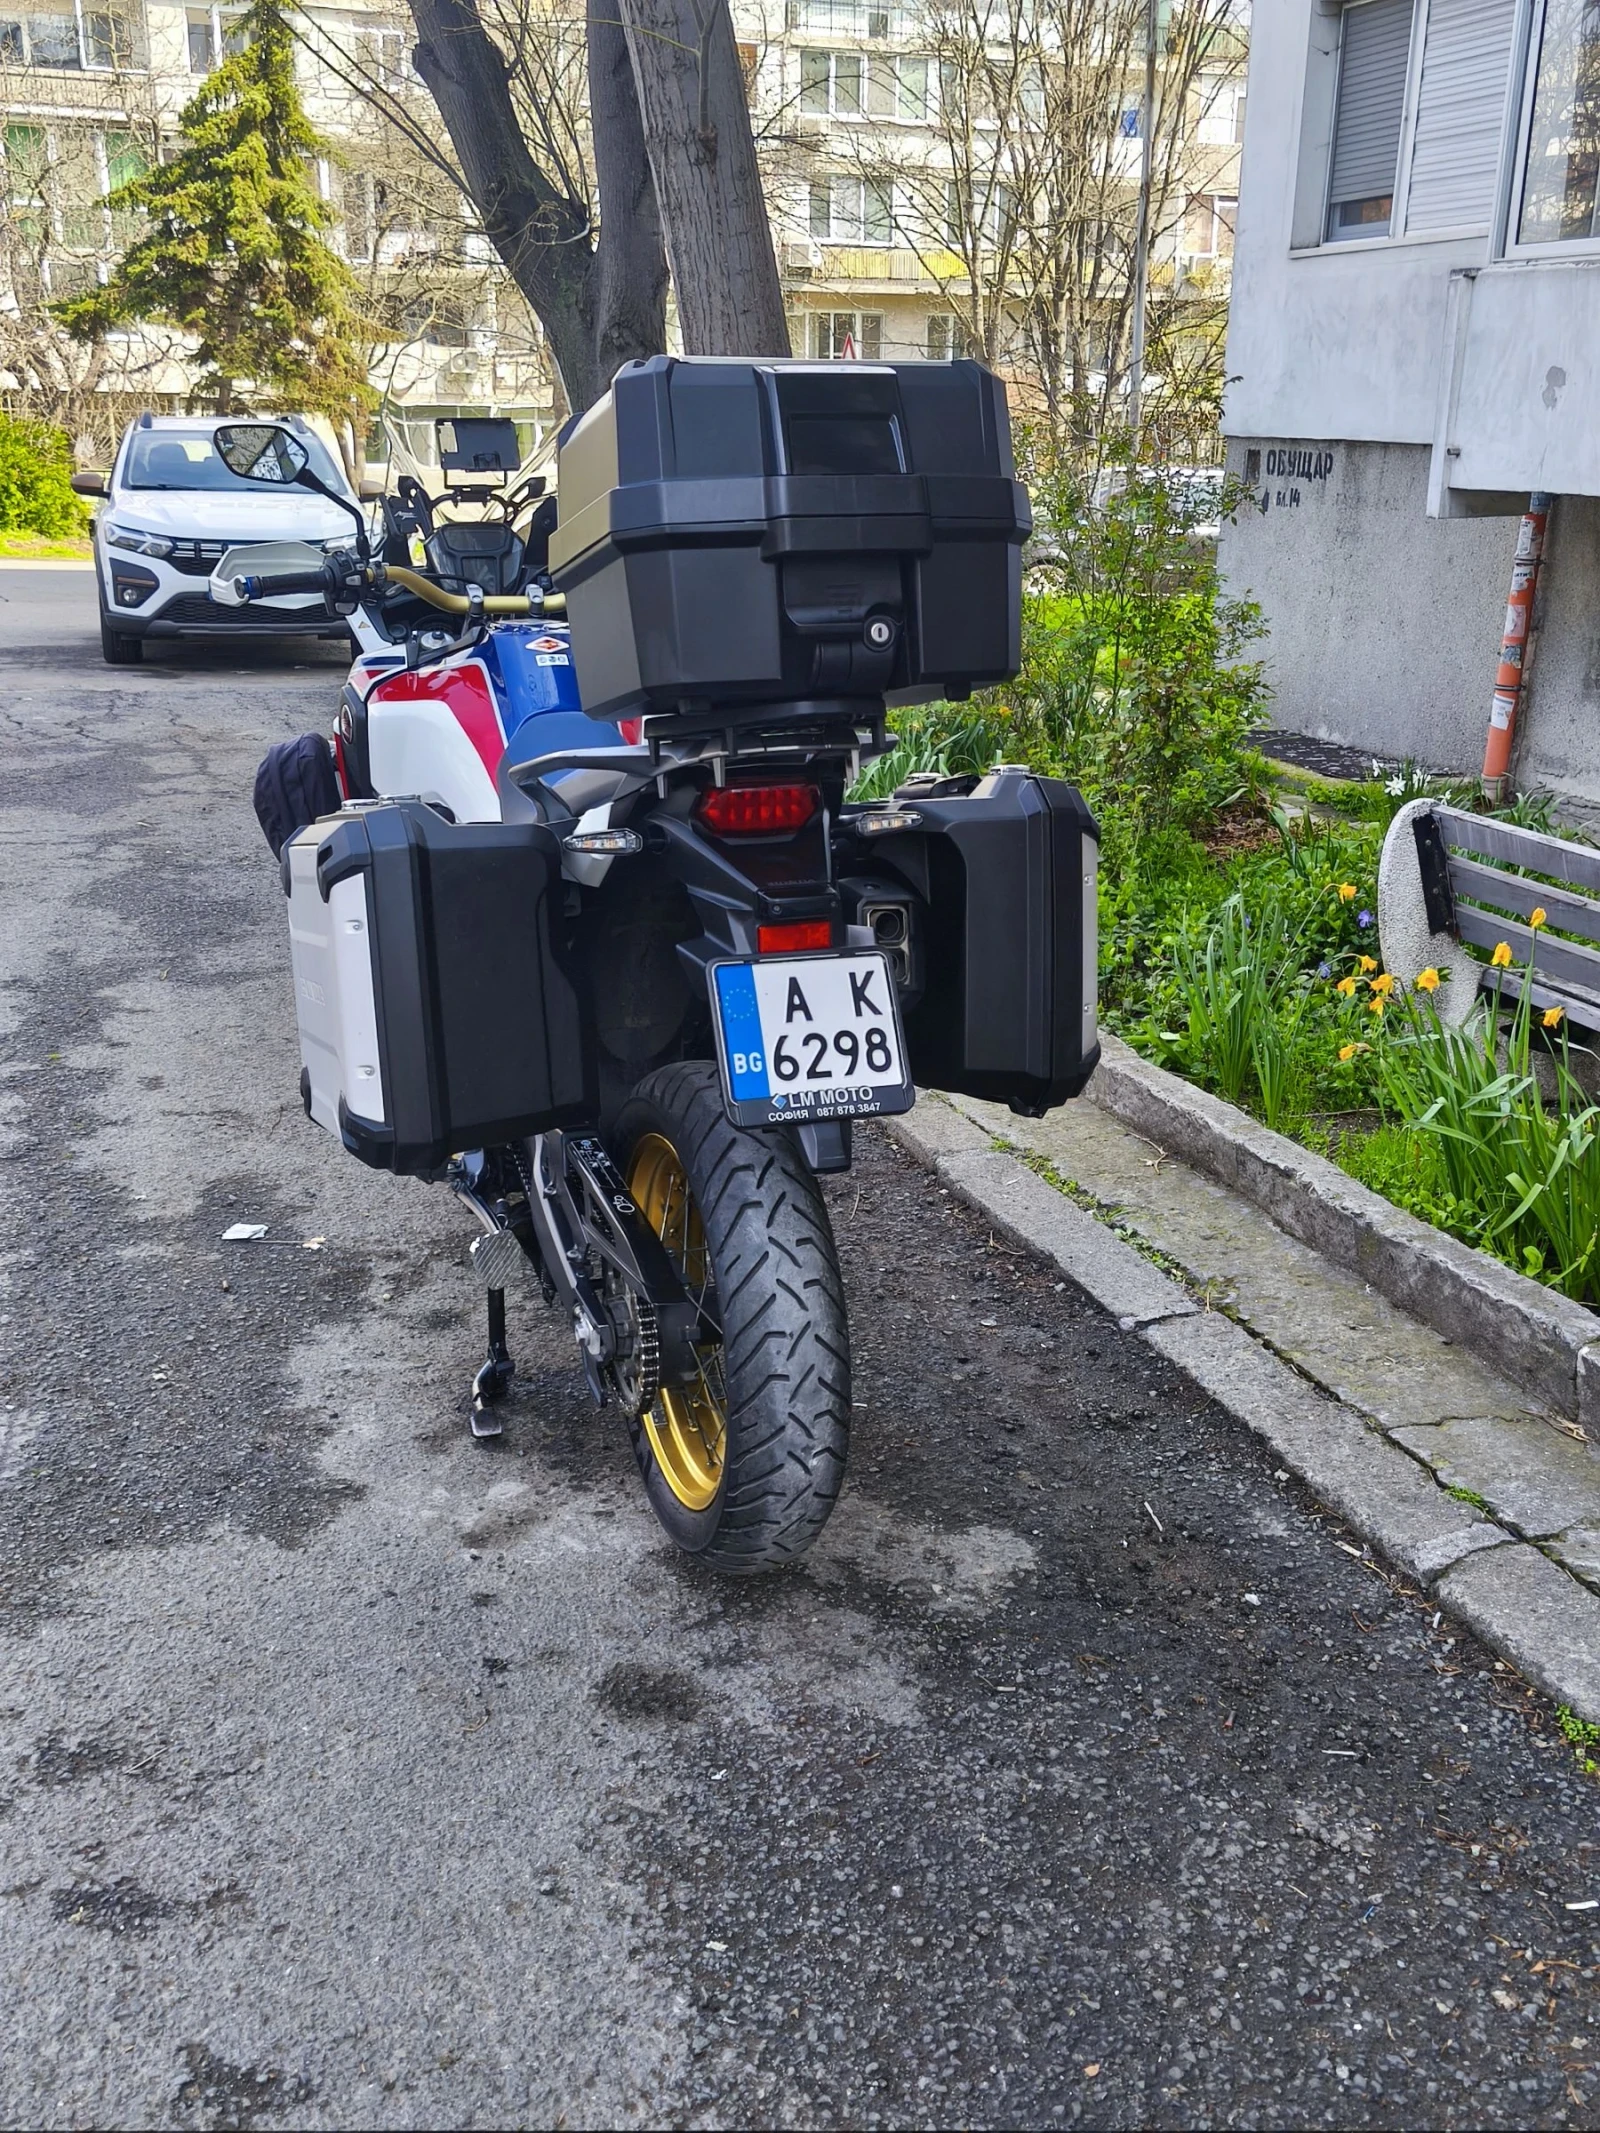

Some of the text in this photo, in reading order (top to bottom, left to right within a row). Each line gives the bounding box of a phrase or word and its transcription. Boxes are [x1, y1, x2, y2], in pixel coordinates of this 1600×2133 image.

[1266, 449, 1334, 482] ОБУЩАР
[785, 970, 883, 1023] A K
[732, 1052, 763, 1075] BG
[773, 1027, 892, 1081] 6298
[788, 1086, 873, 1108] LM MOTO
[768, 1102, 881, 1122] СОФИЯ 087 878 3847
